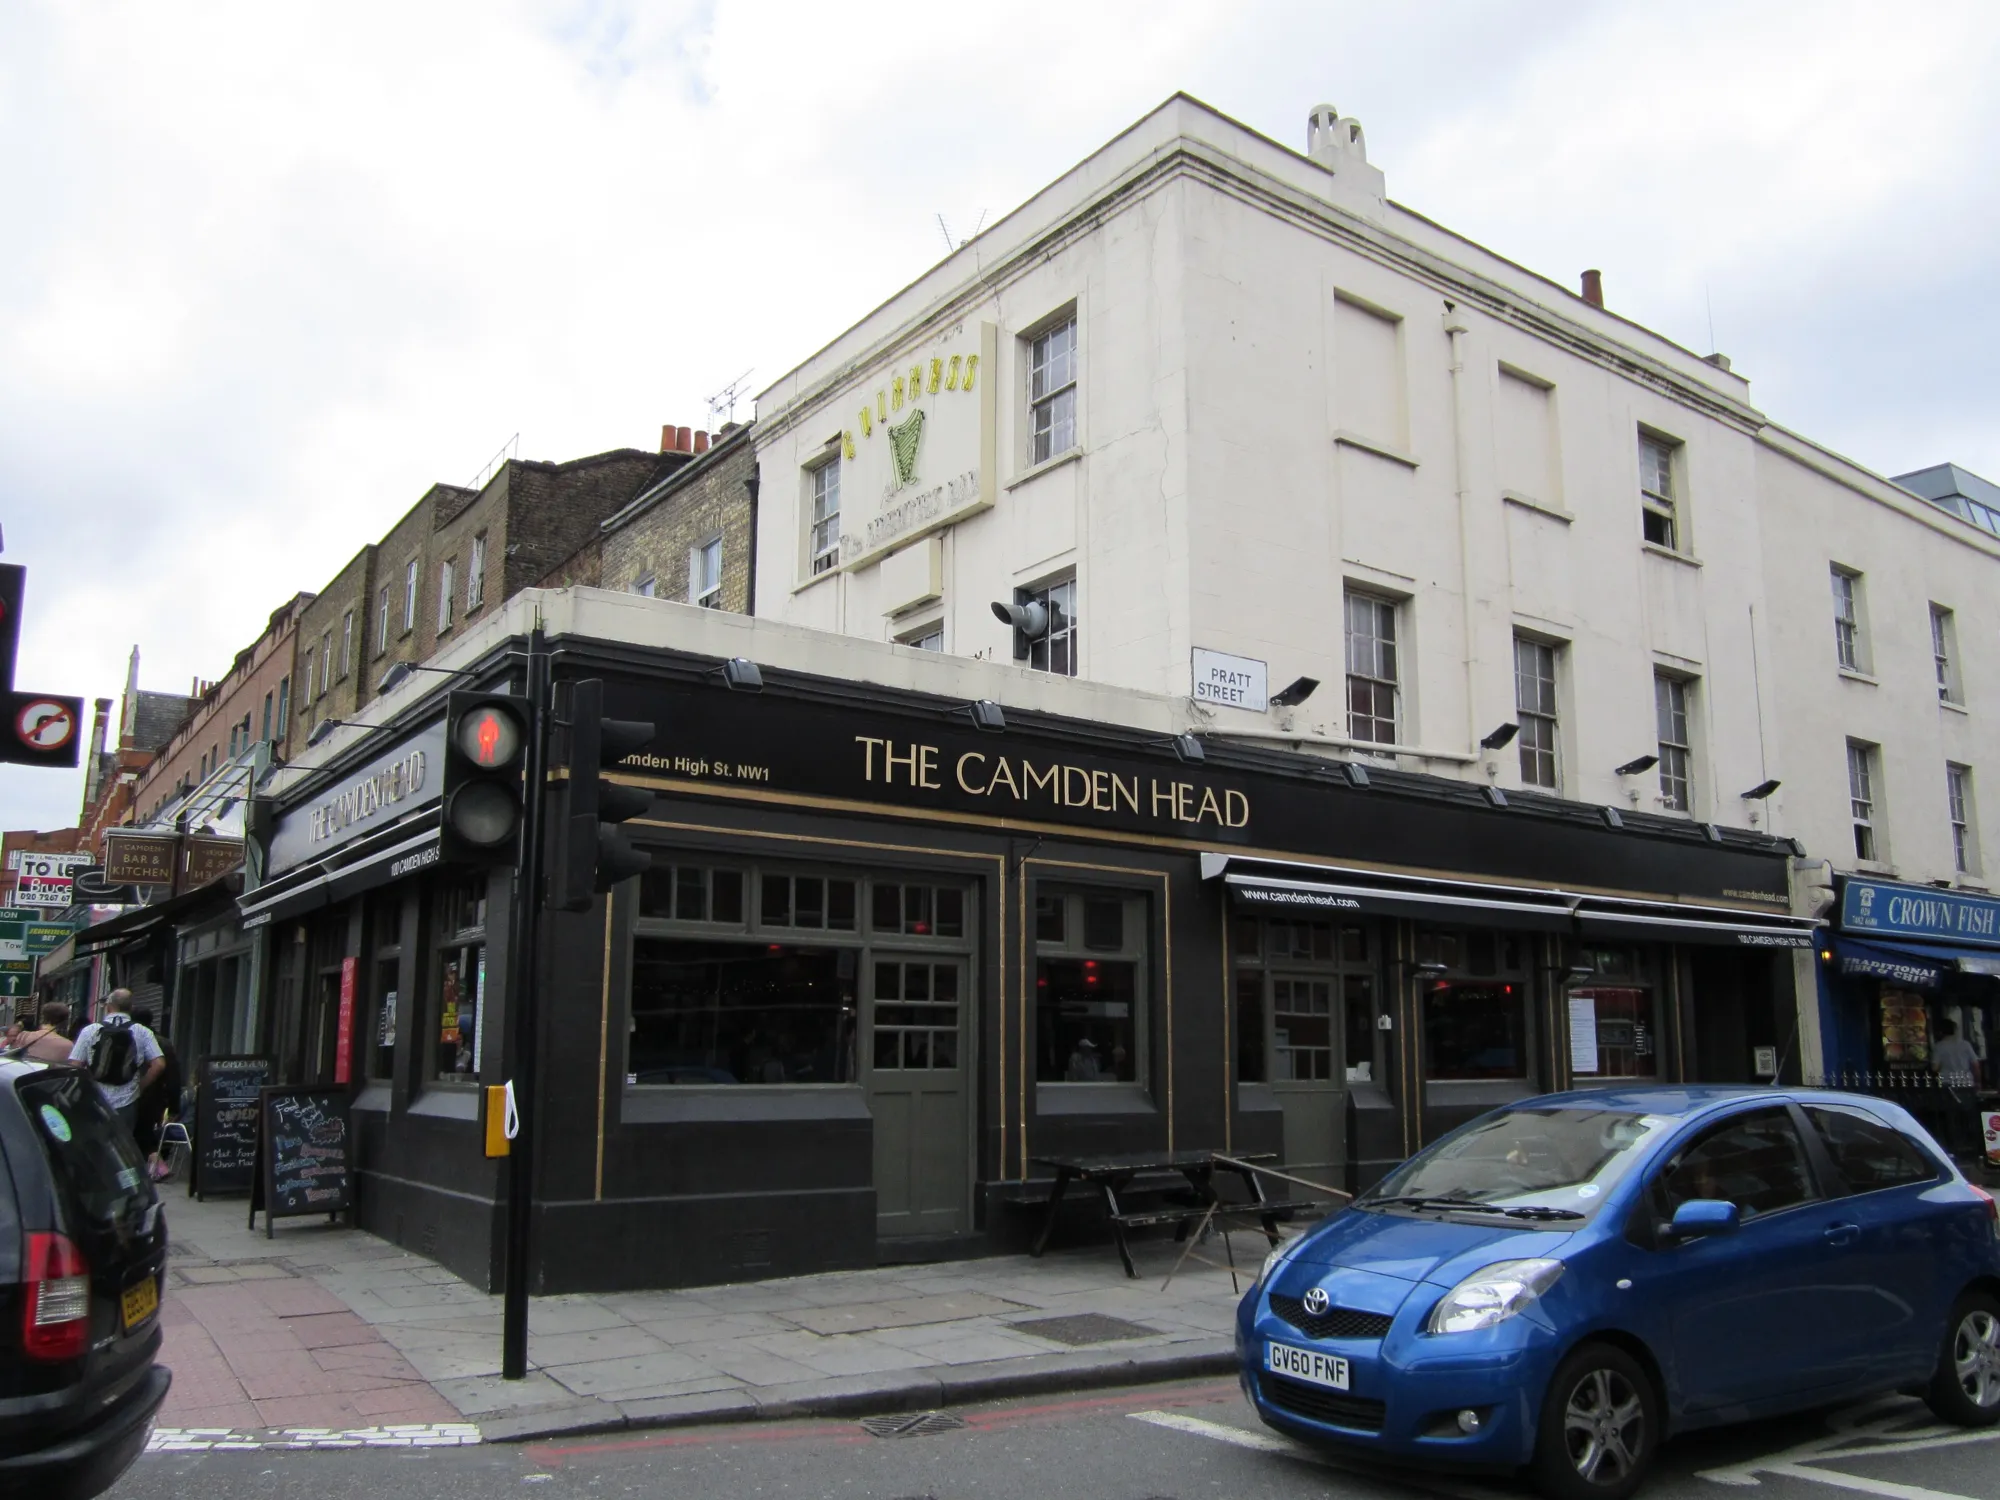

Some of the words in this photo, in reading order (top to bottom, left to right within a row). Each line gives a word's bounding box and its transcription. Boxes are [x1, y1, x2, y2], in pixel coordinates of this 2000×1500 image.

[1211, 668, 1251, 687] PRATT
[1198, 681, 1244, 703] STREET
[674, 756, 708, 776] High
[713, 761, 733, 777] St.
[737, 764, 769, 781] NW1
[855, 736, 941, 789] THE
[956, 752, 1139, 815] CAMDEN
[1152, 779, 1249, 828] HEAD
[308, 801, 329, 843] THE
[328, 774, 381, 832] CAMDEN
[381, 751, 425, 807] HEAD
[124, 844, 162, 852] CAMDEN
[123, 853, 148, 864] BAR
[152, 855, 160, 865] &
[399, 853, 421, 874] CAMDEN
[420, 847, 436, 866] HIGH
[25, 862, 51, 876] TO
[111, 866, 170, 878] KITCHEN
[30, 878, 73, 894] Bruce
[20, 892, 36, 900] 020
[40, 893, 58, 901] 7267
[1241, 887, 1361, 910] www.camdenhead.com
[1722, 888, 1789, 904] www.camdenhead.com
[1888, 896, 1954, 929] CROWN
[1958, 904, 1997, 934] FISH
[29, 927, 71, 936] JENNINGS
[1738, 934, 1749, 944] 100
[1749, 935, 1775, 945] CAMDEN
[1774, 937, 1789, 946] HIGH
[5, 941, 22, 949] Tow
[1843, 957, 1938, 978] TRADITIONAL
[1272, 1345, 1310, 1375] GV60
[1314, 1355, 1345, 1383] FNF
